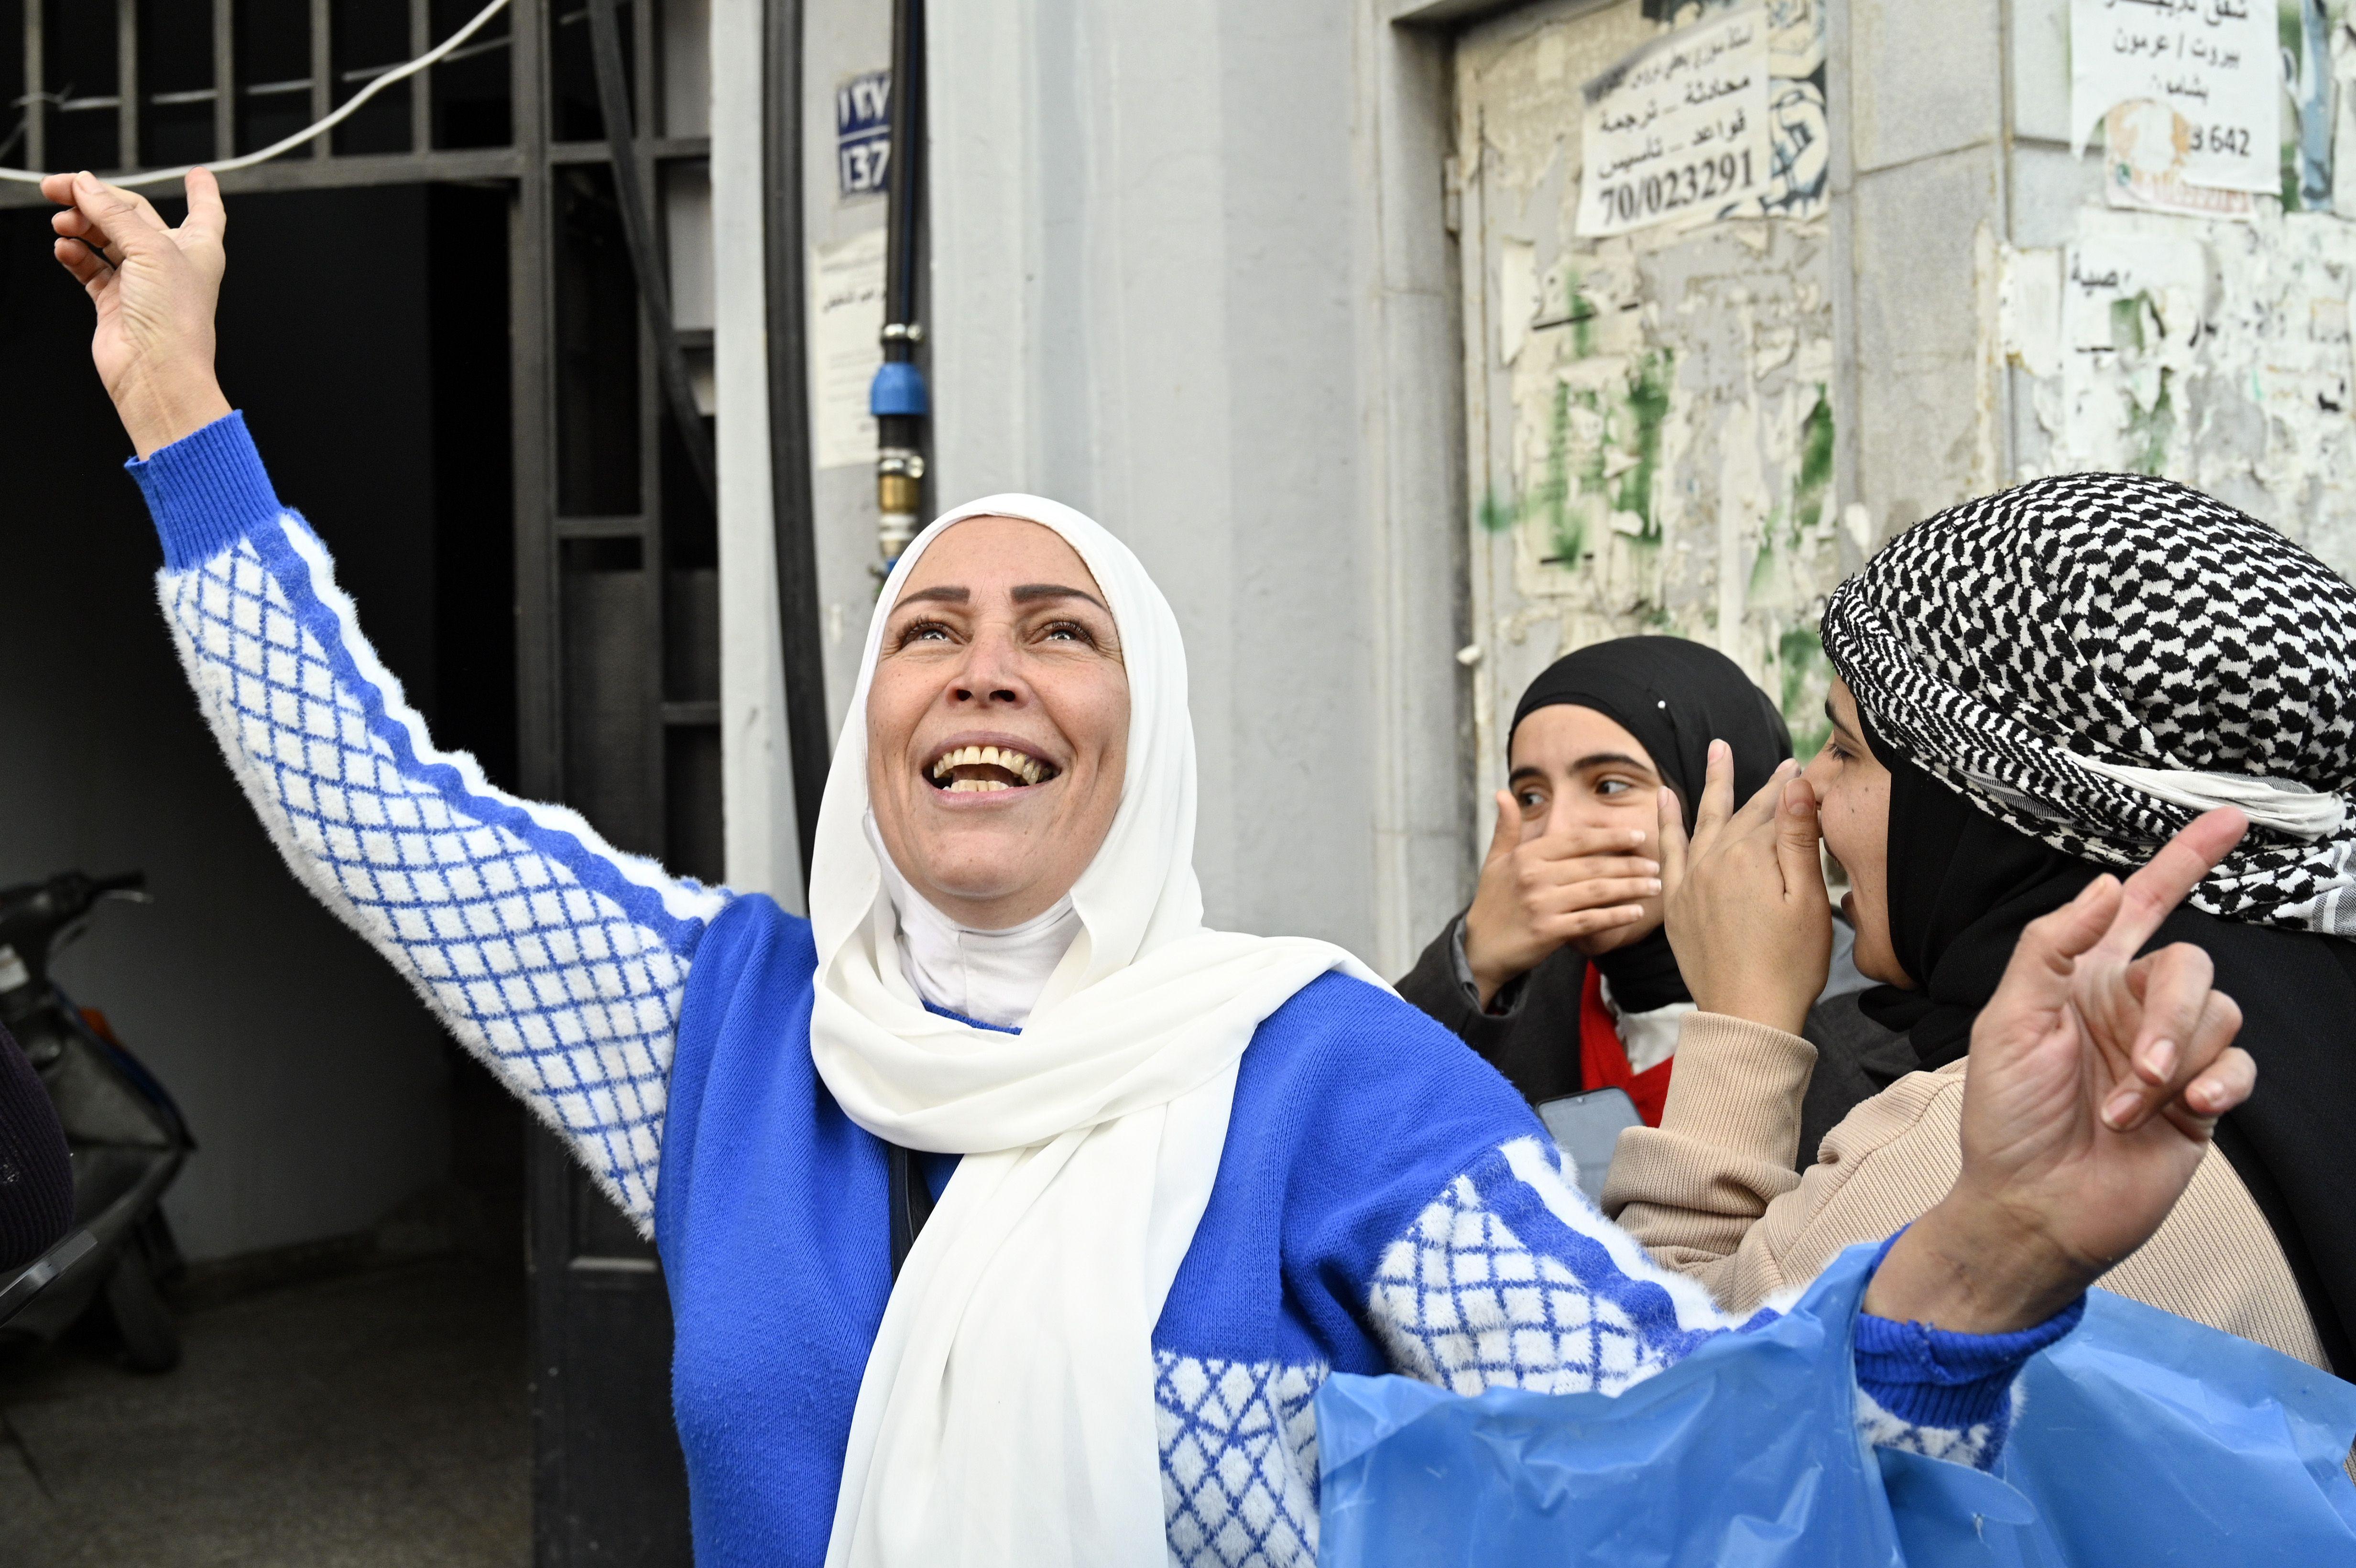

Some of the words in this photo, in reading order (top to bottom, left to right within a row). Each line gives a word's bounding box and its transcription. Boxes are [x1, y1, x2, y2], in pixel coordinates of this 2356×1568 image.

[2113, 27, 2170, 58] عرمون
[2191, 38, 2240, 70] بيروت
[1684, 76, 1751, 105] محادثة
[1600, 99, 1658, 132] ترجمة
[1691, 107, 1746, 146] قواعد
[841, 139, 891, 192] 137
[1599, 148, 1756, 226] 70/023291
